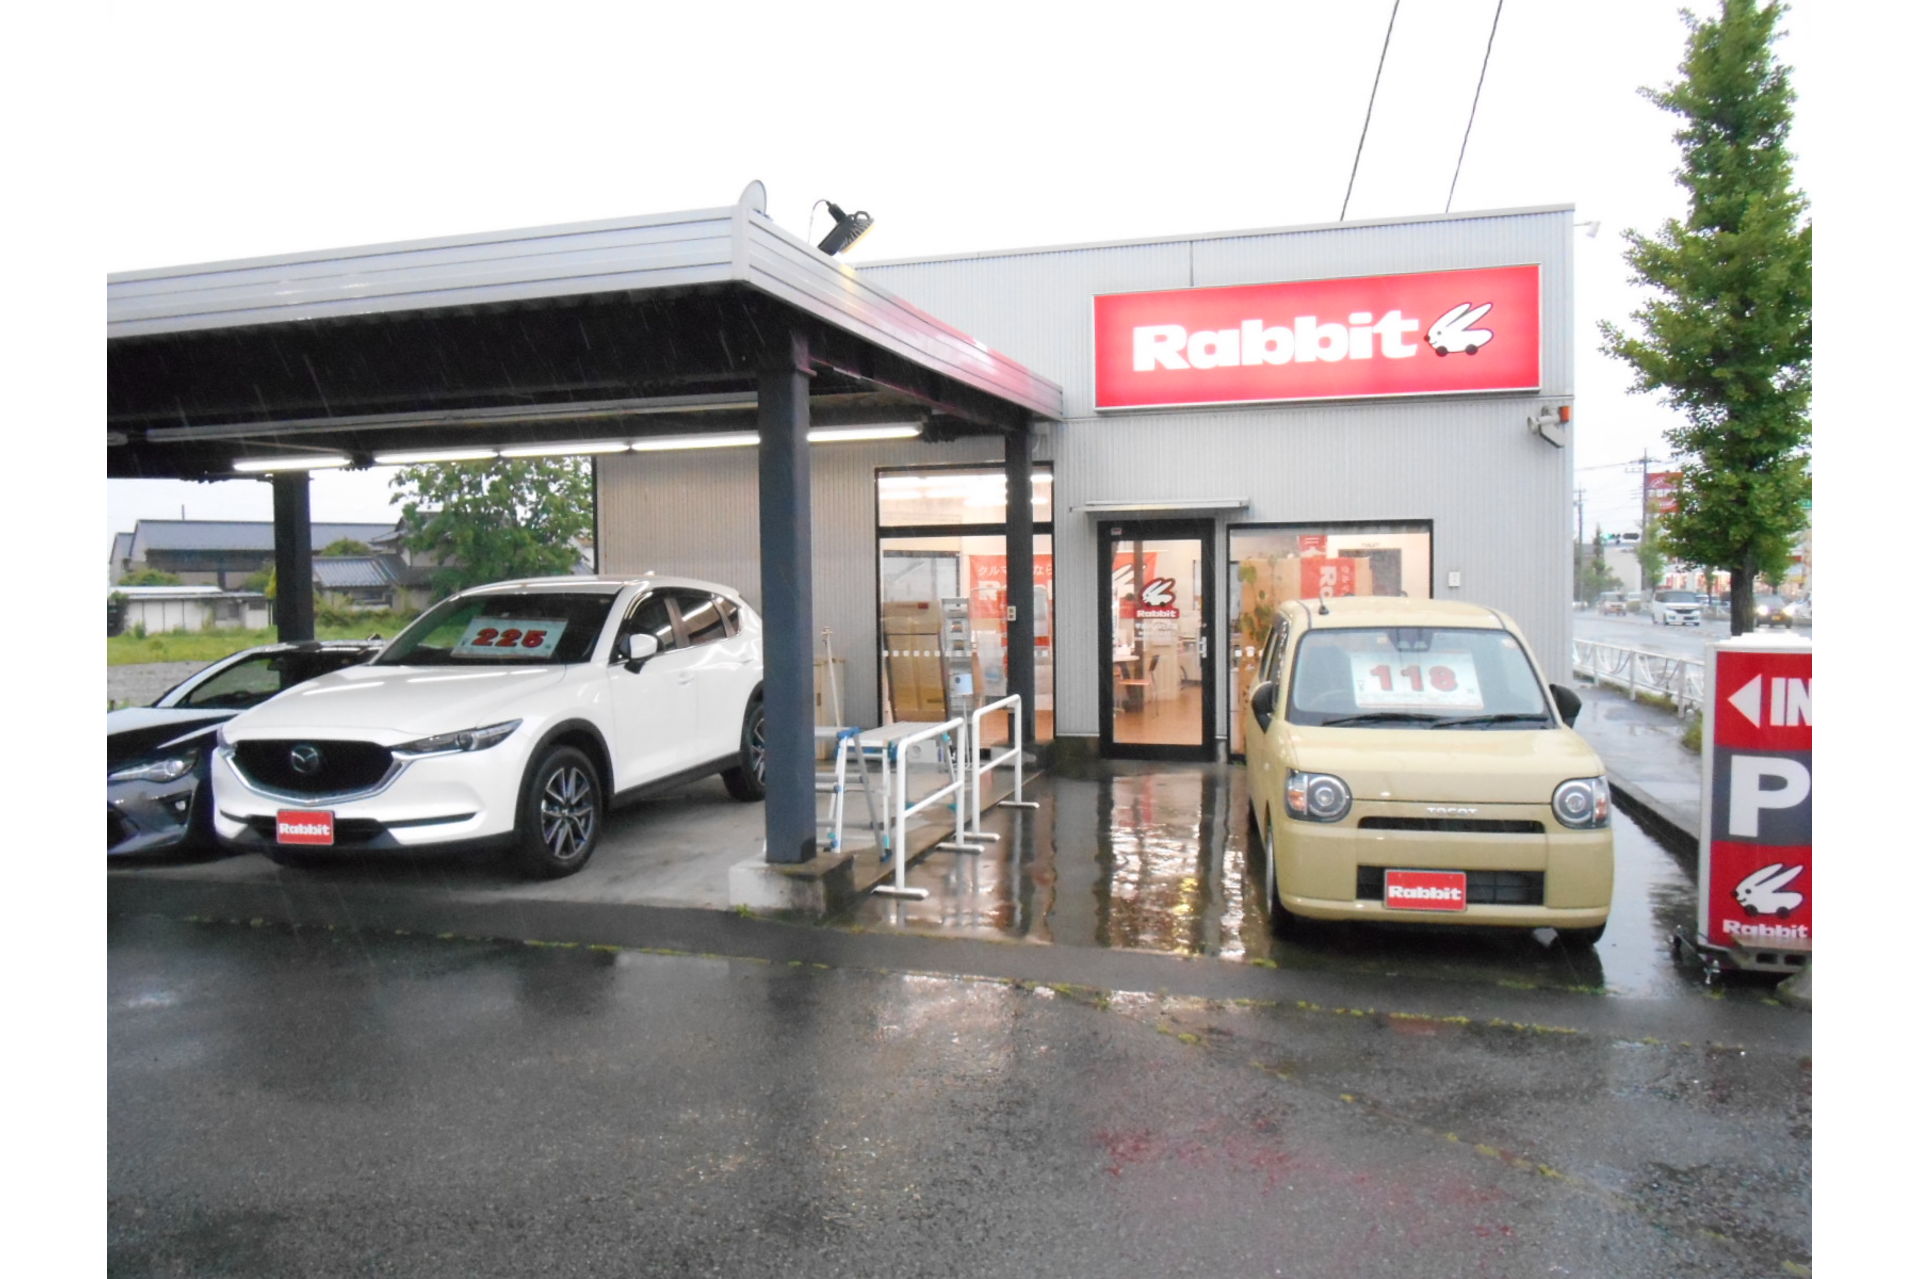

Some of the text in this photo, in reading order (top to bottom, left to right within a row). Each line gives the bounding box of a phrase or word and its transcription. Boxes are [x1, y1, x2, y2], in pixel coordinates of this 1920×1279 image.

[1133, 310, 1419, 372] Rabbit
[1136, 609, 1177, 618] Rabbit
[471, 627, 548, 649] 225
[1369, 664, 1458, 692] 118
[1729, 755, 1811, 837] P
[279, 822, 331, 836] Rabbit
[1388, 885, 1462, 900] Rabbit
[1722, 919, 1809, 938] Rabbit
